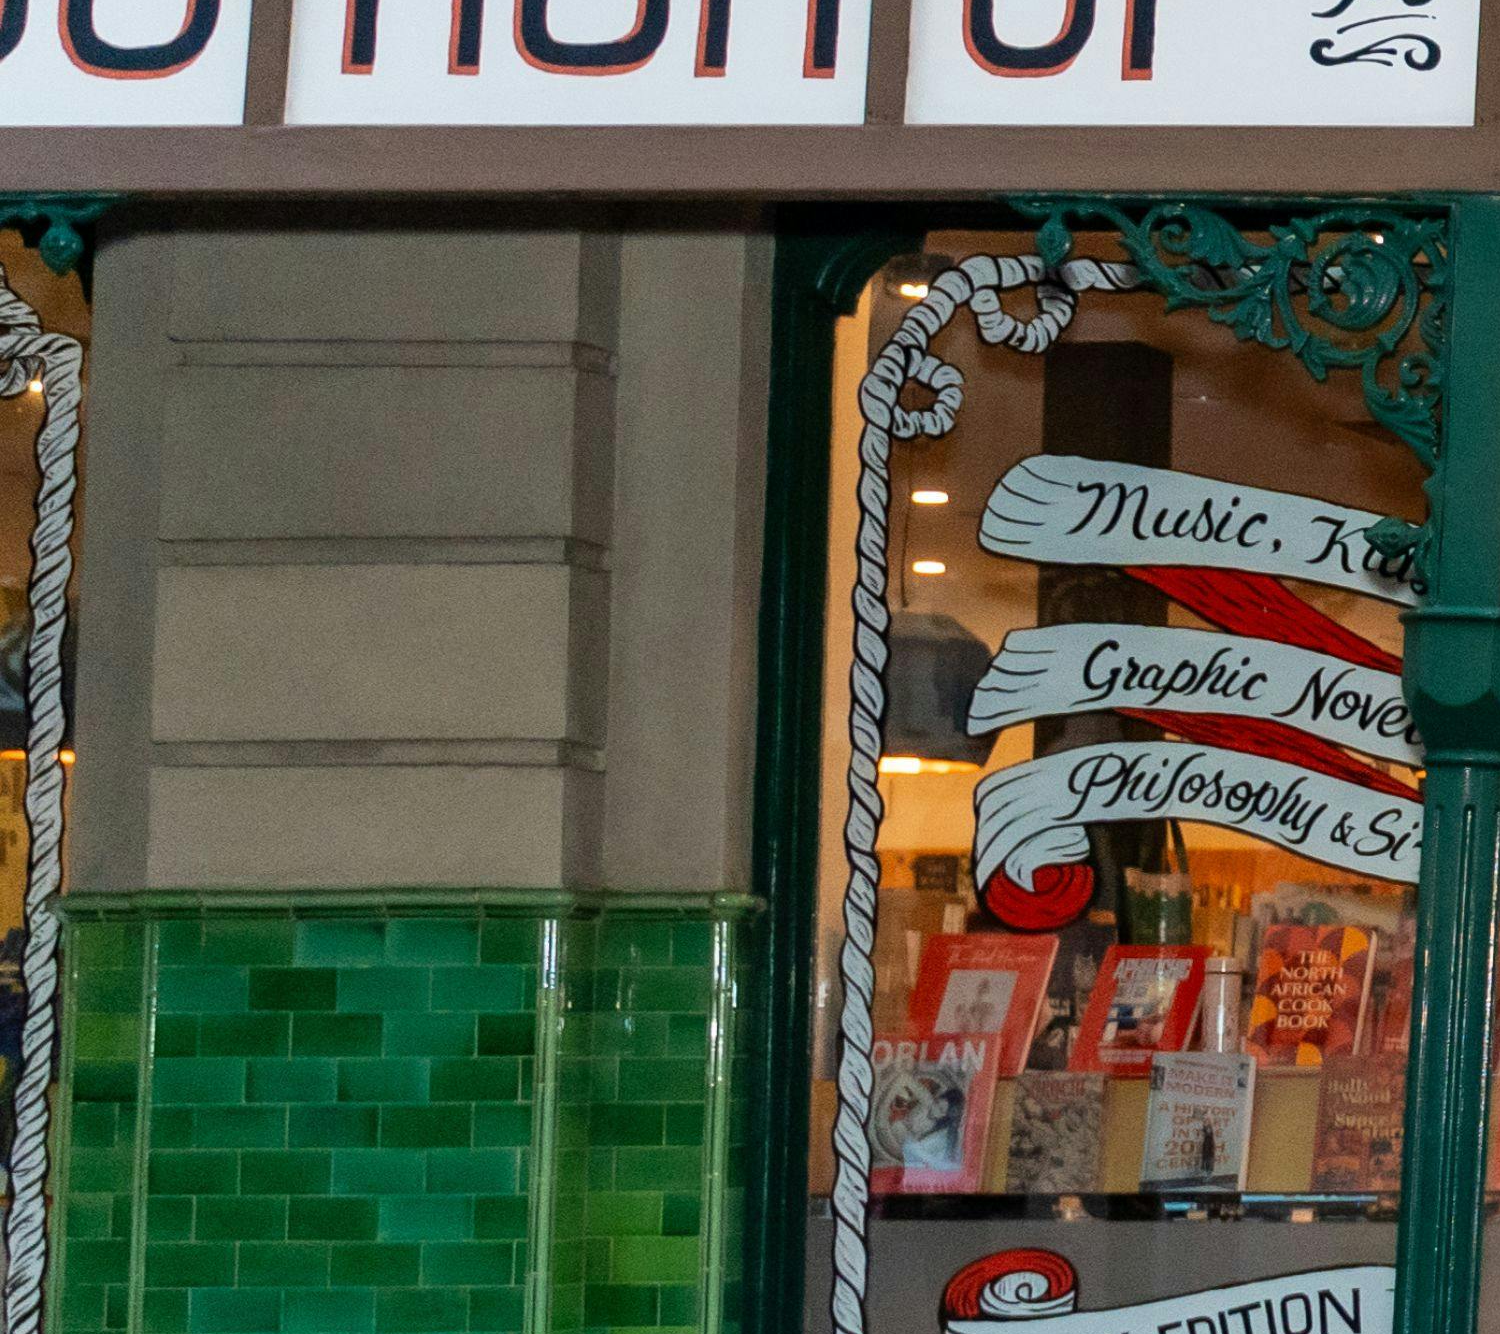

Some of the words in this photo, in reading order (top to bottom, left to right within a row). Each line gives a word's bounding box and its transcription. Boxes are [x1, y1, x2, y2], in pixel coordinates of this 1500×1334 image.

[1066, 481, 1282, 553] Music,
[1070, 640, 1268, 706] Graphic
[1052, 753, 1328, 845] Philosophy
[1330, 812, 1355, 847] &
[1299, 950, 1329, 964] THE
[1279, 967, 1344, 981] NORTH
[1271, 982, 1347, 996] AFRICAN
[1278, 998, 1333, 1013] COOK
[1277, 1014, 1329, 1028] BOOK
